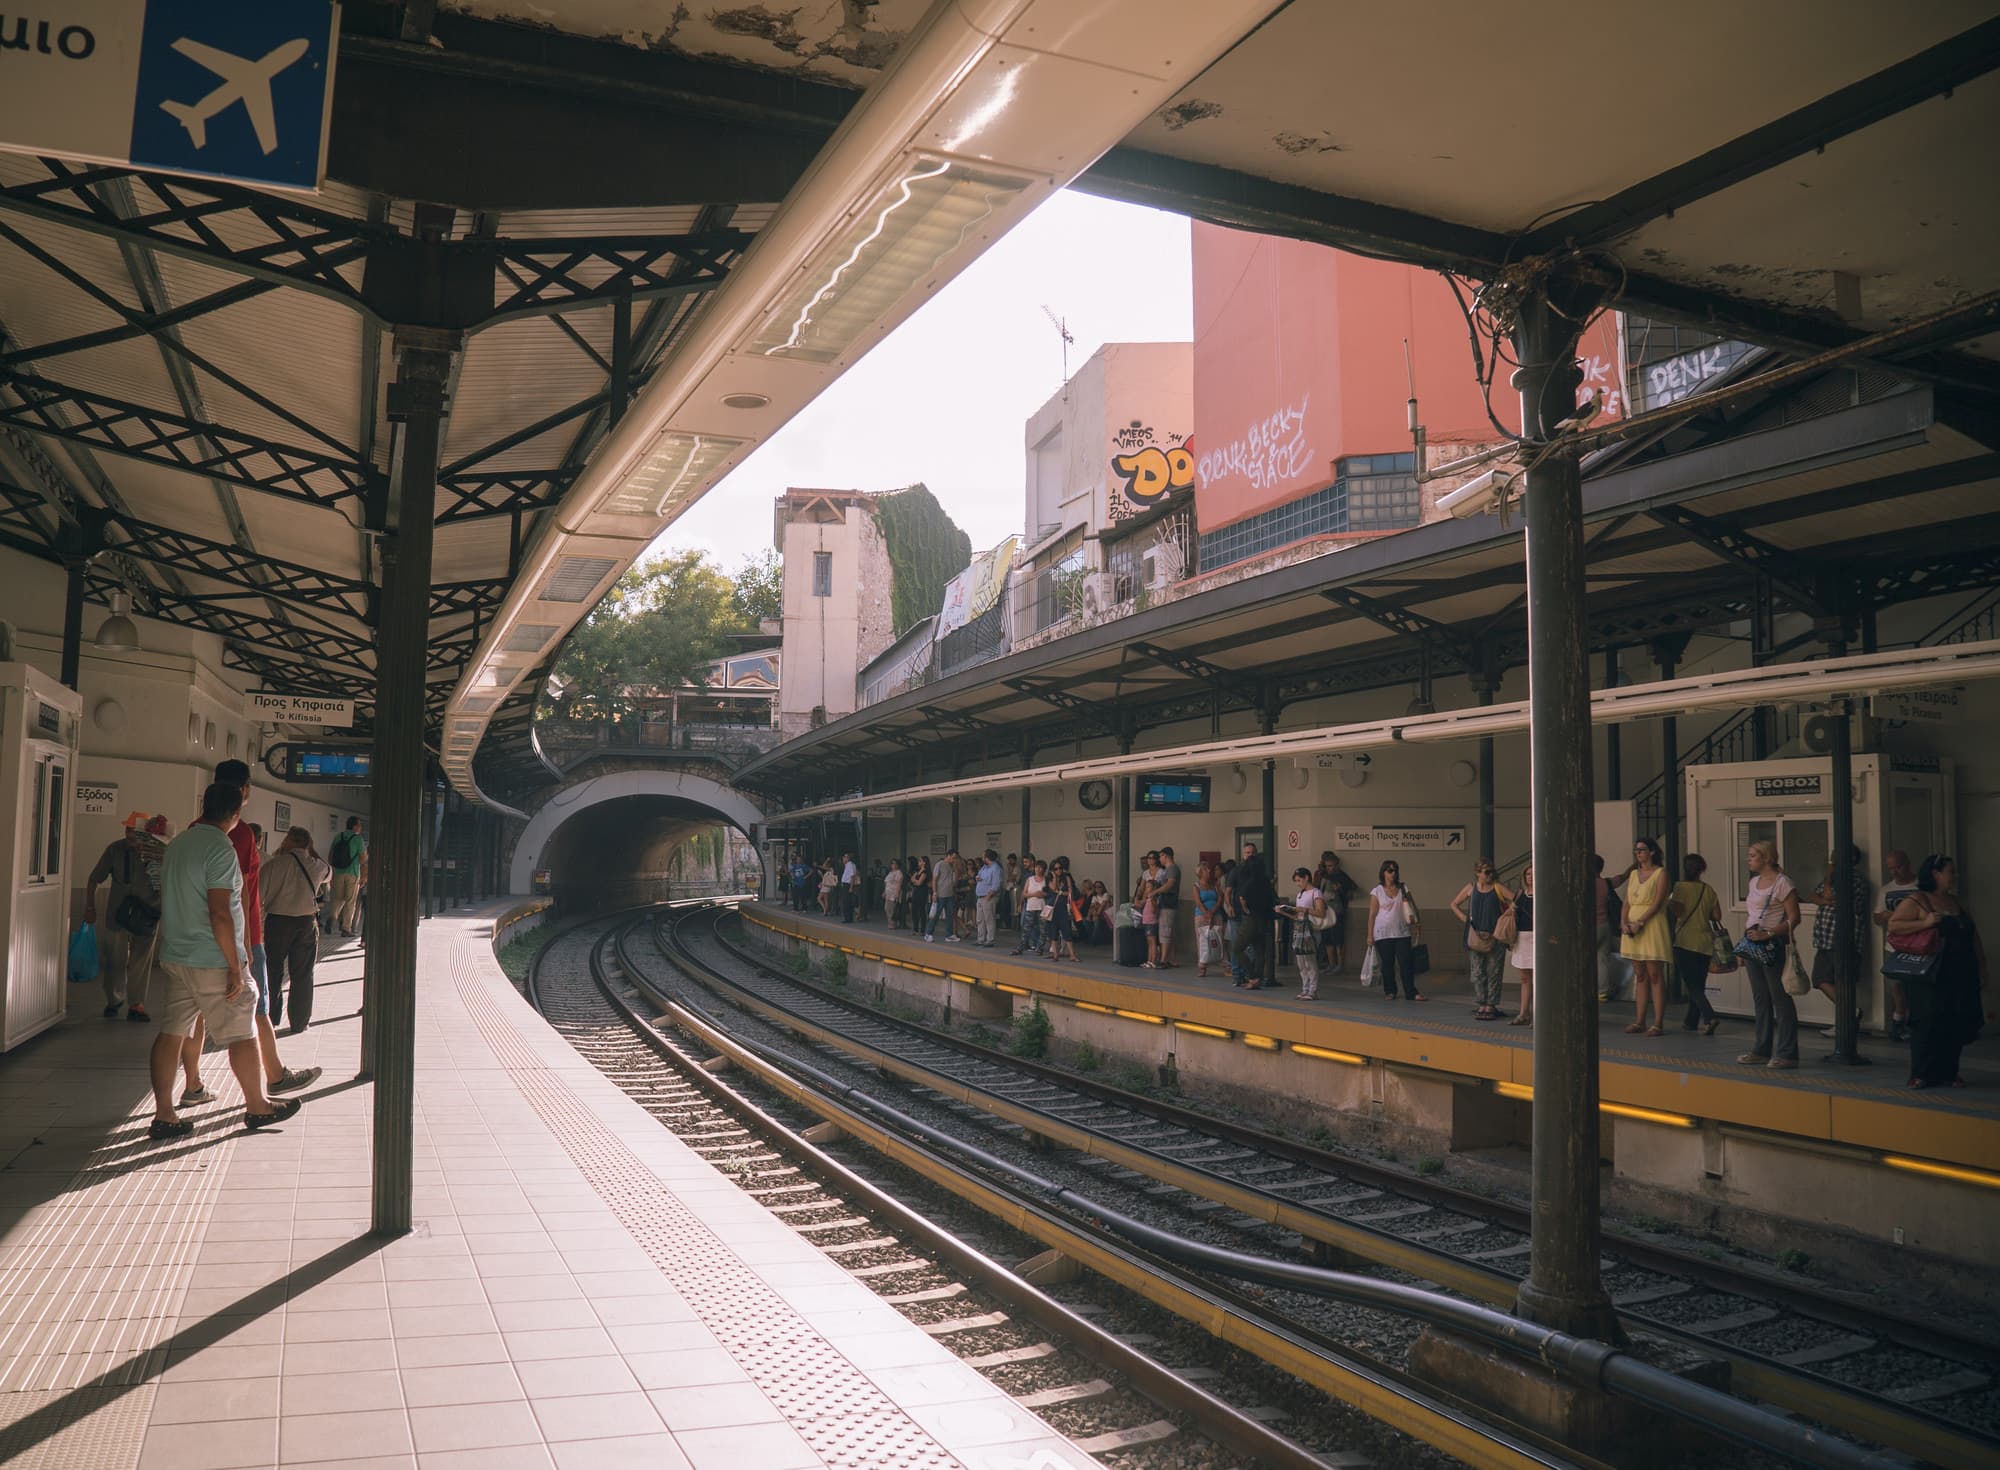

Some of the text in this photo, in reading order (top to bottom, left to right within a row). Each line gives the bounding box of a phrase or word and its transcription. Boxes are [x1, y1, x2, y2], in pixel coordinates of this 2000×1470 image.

[1651, 346, 1726, 394] DENK
[1119, 427, 1153, 440] MEOS
[254, 695, 345, 711] Προς Κηφισιά
[274, 711, 322, 722] To Kifissia
[1756, 776, 1819, 789] ISOBOX
[86, 804, 102, 813] Exit
[1376, 832, 1439, 842] Προς Κηφισιά
